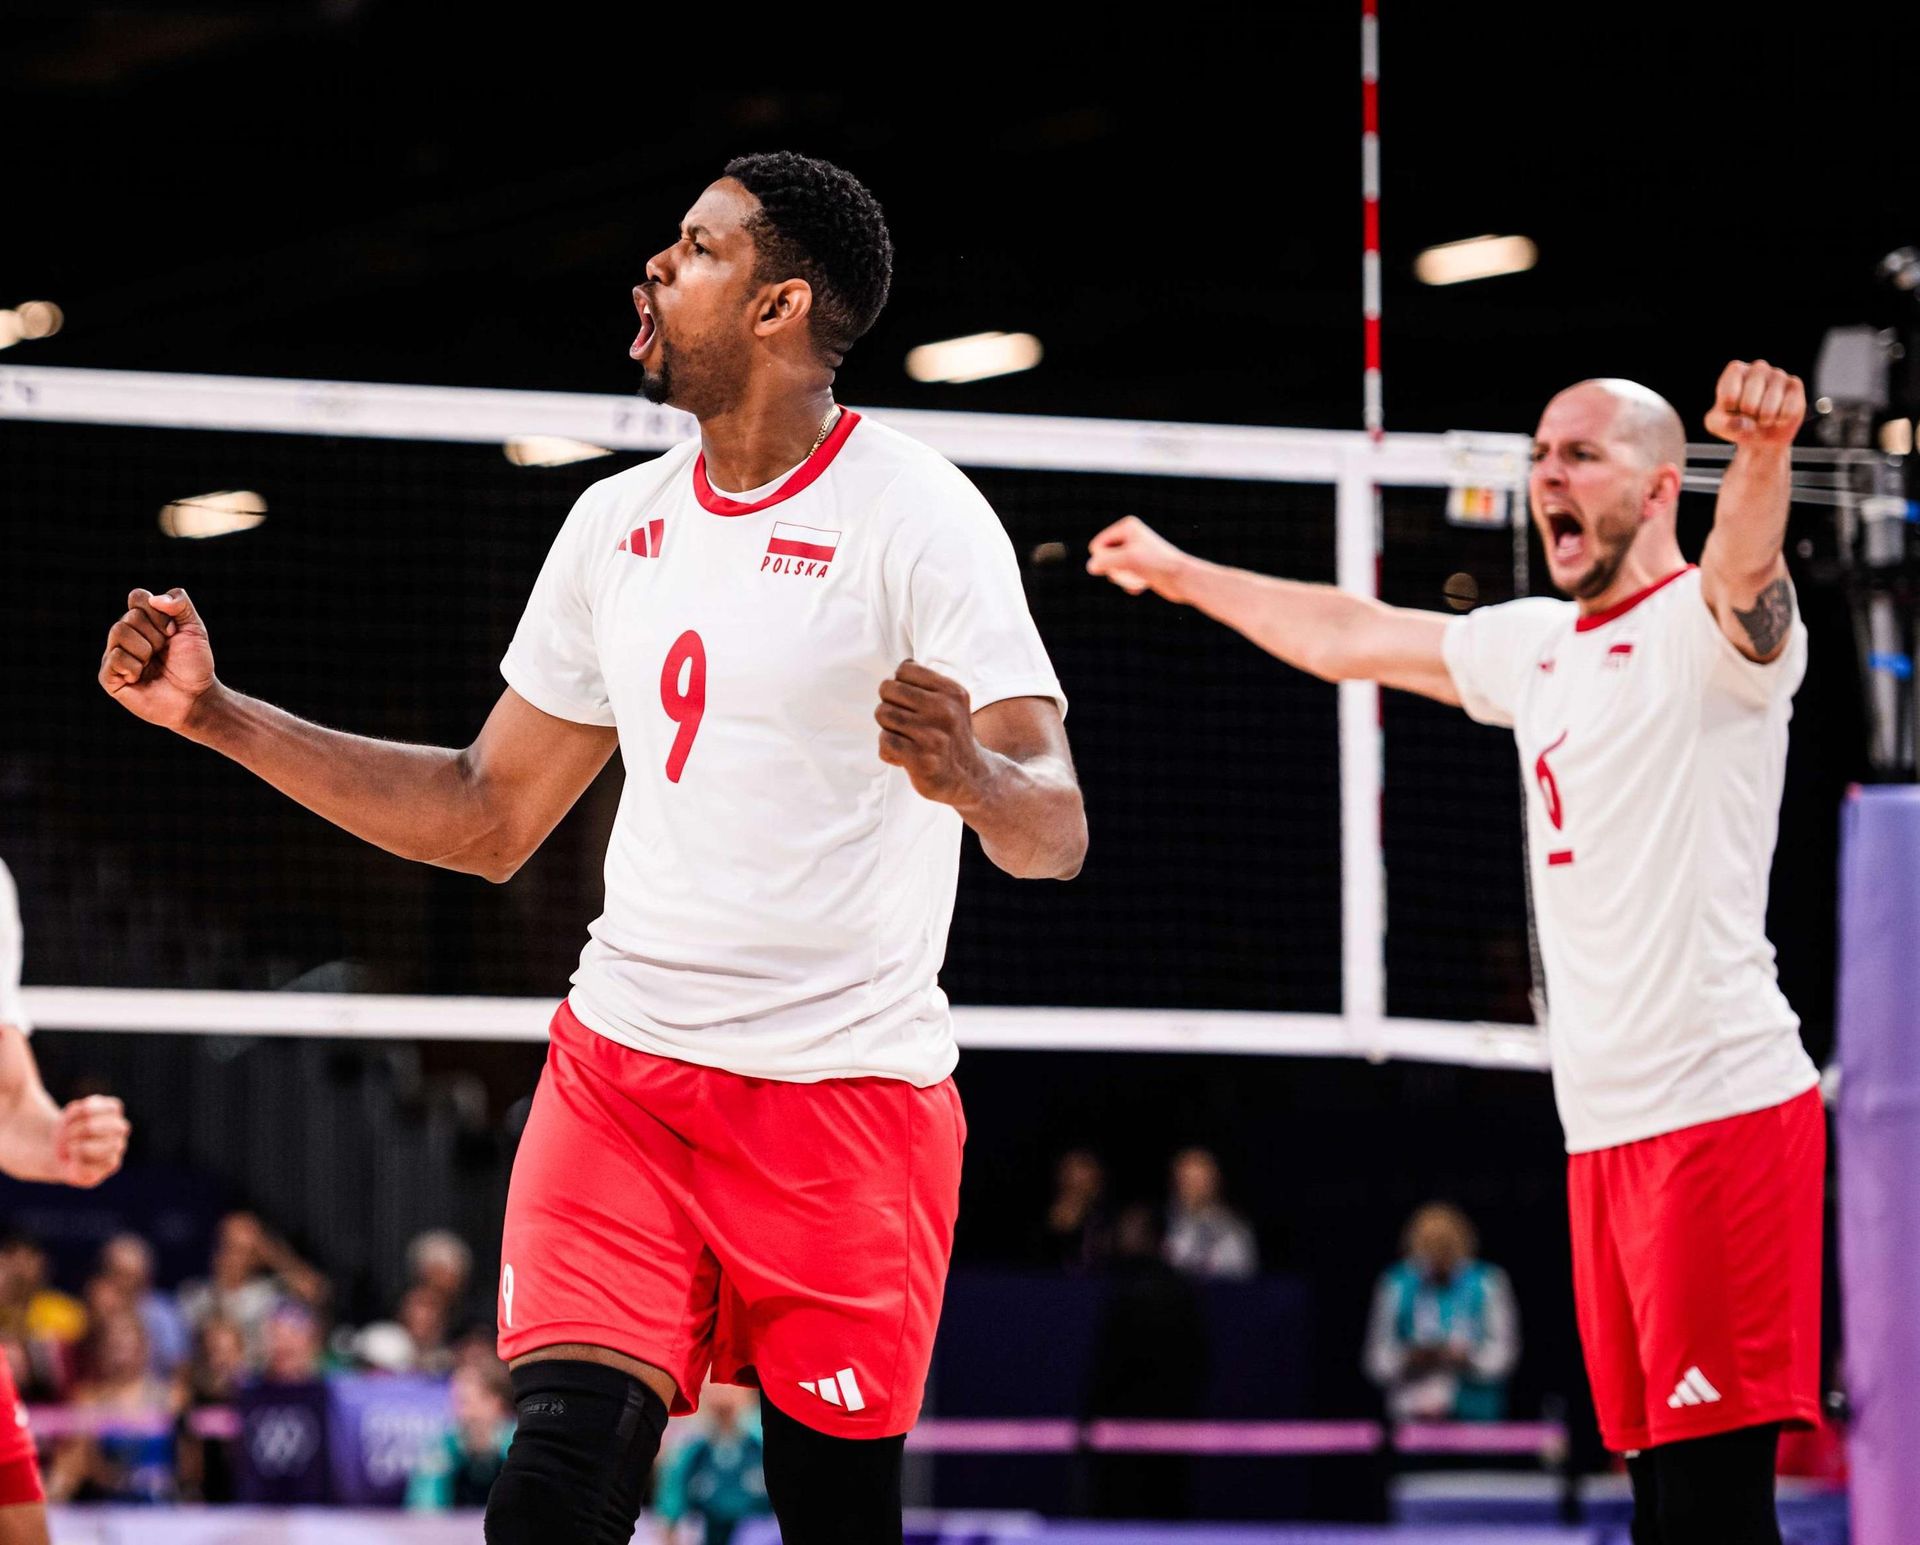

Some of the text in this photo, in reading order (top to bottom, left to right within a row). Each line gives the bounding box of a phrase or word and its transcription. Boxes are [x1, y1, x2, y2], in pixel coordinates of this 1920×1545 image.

[760, 556, 829, 578] POLSKA
[660, 629, 707, 783] 9
[1536, 730, 1568, 830] 6
[502, 1263, 514, 1328] 9
